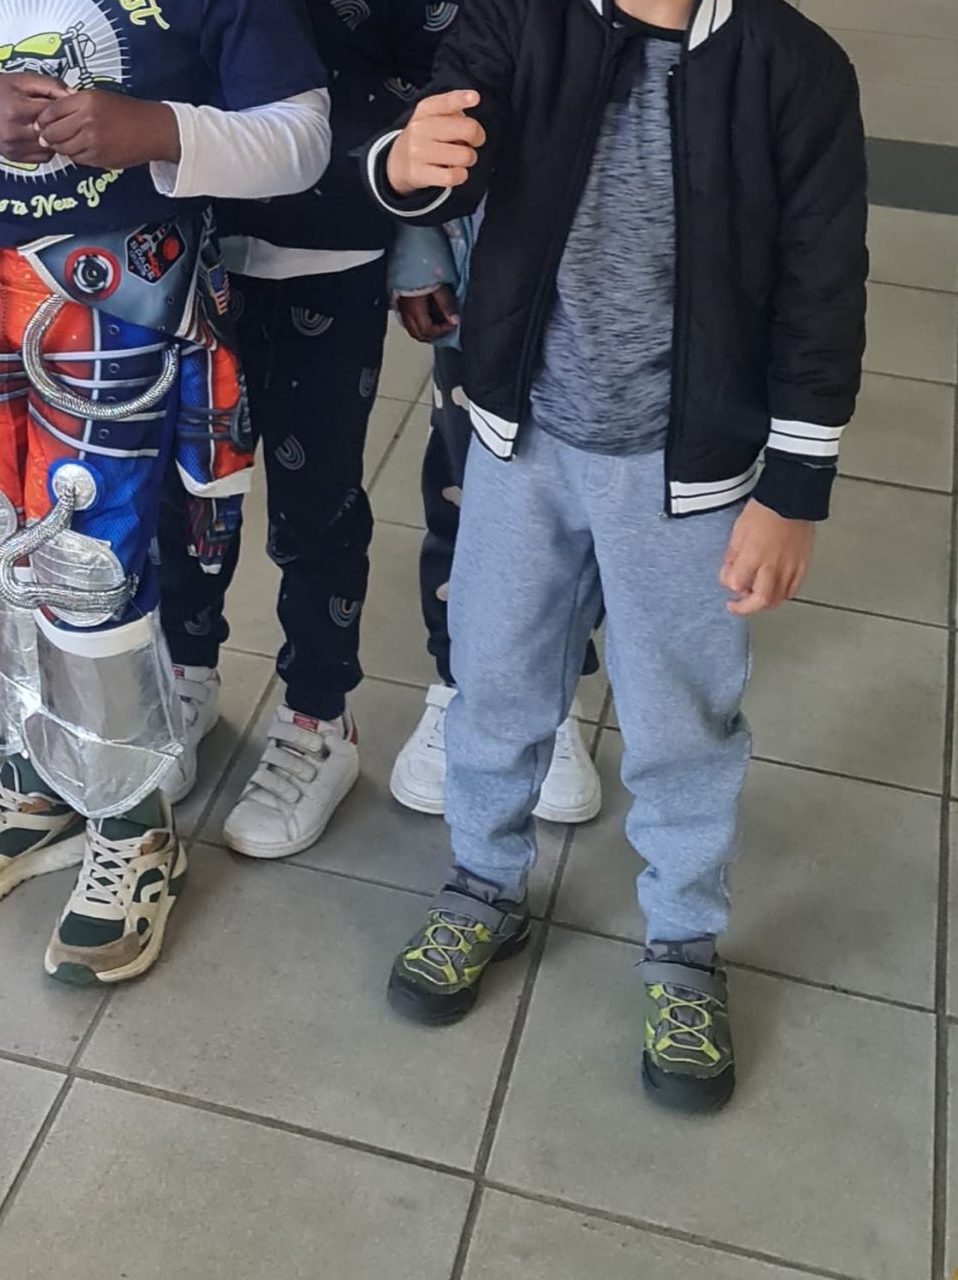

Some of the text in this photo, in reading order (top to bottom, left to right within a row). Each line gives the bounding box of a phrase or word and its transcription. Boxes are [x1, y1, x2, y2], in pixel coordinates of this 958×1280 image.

[10, 199, 29, 216] to
[30, 193, 78, 218] New
[129, 239, 155, 280] SPACE
